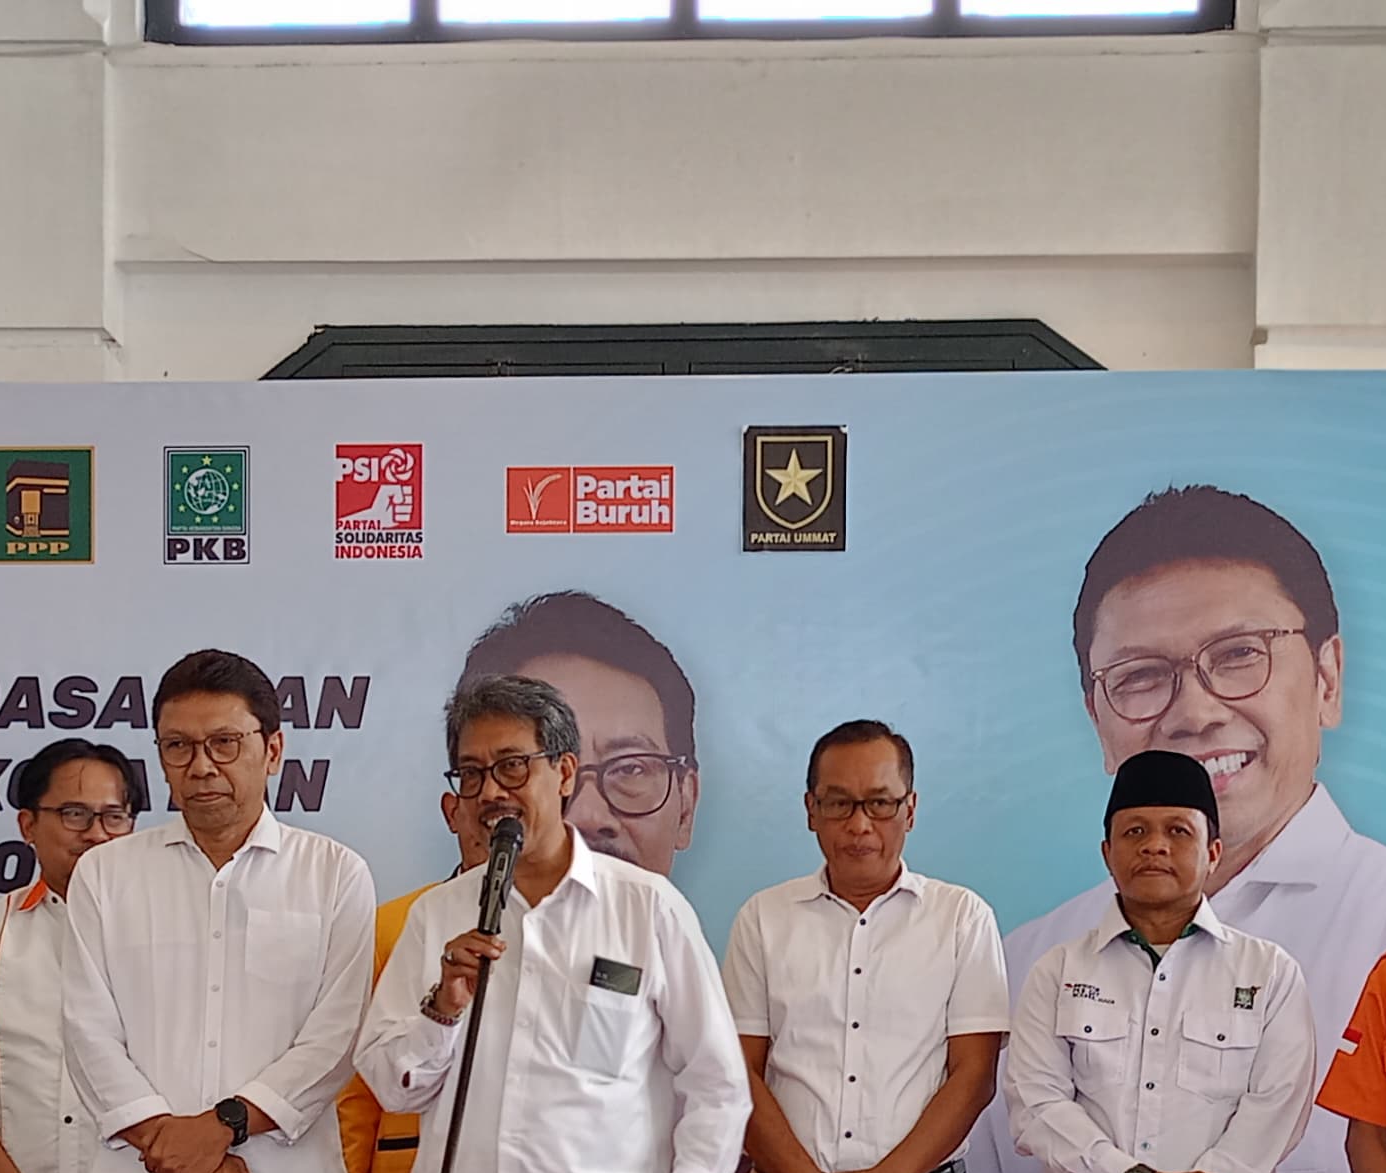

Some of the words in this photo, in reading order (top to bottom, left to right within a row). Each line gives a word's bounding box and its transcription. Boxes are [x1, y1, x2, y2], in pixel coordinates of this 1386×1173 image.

[335, 457, 380, 482] PSI
[576, 474, 670, 499] Partai
[576, 500, 670, 525] Buruh
[336, 520, 381, 530] PARTAI
[335, 532, 423, 544] SOLIDARITAS
[751, 533, 791, 543] PARTAI
[794, 532, 837, 543] UMMAT
[6, 541, 70, 554] PPP
[167, 538, 247, 561] PKB
[335, 545, 423, 559] INDONESIA
